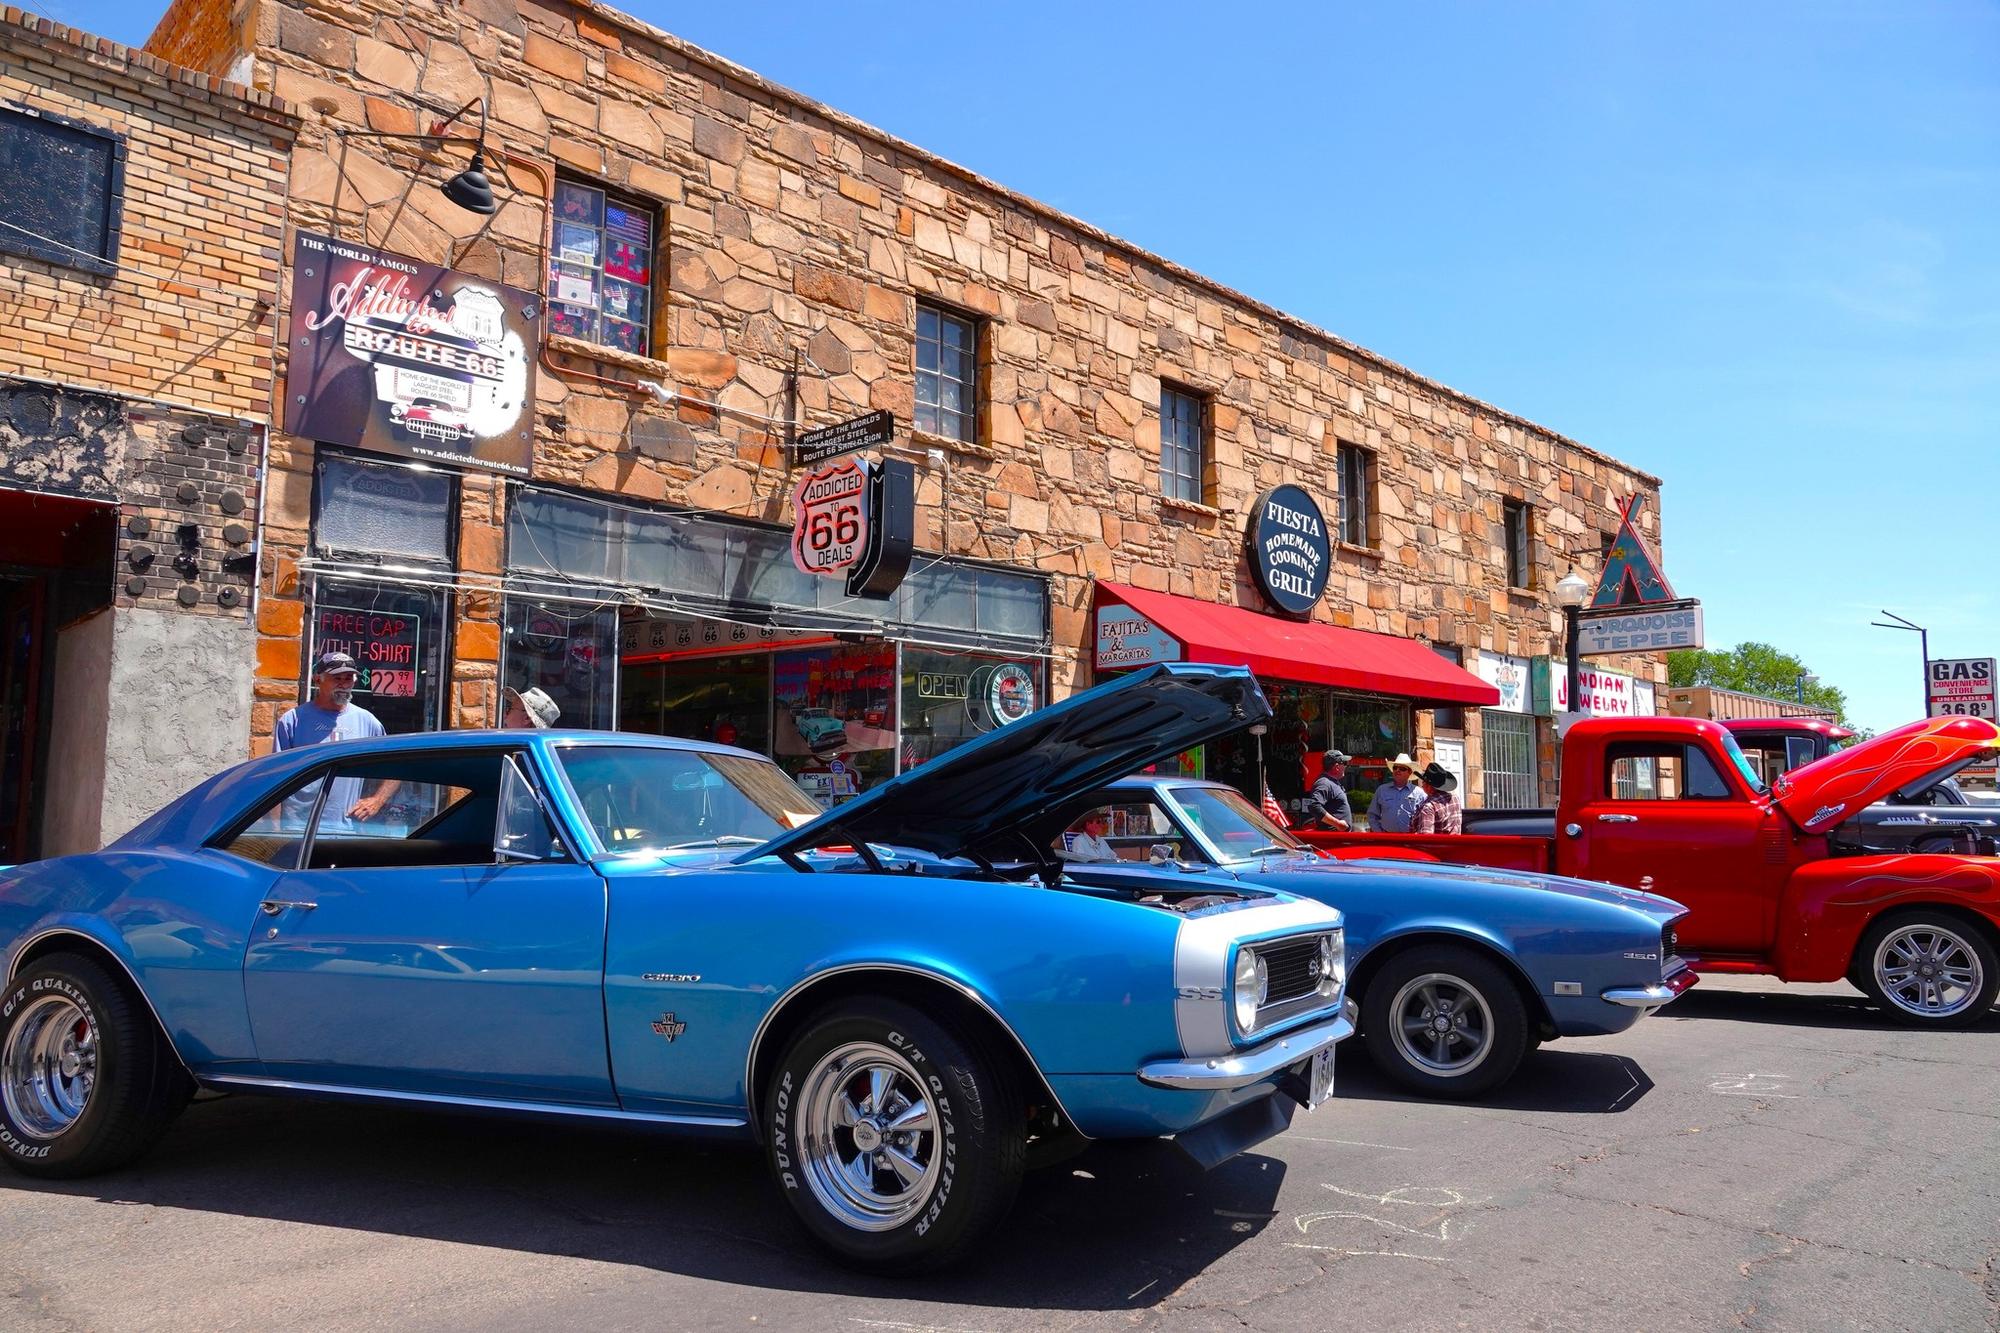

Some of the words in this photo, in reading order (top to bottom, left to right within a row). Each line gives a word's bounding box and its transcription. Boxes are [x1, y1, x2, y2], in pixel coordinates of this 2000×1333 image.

[301, 238, 325, 252] THE
[327, 244, 370, 263] WORLD
[372, 255, 418, 275] FAMOUS
[305, 267, 456, 331] Addicted
[406, 317, 437, 335] to
[354, 327, 456, 370] ROUTE
[466, 353, 498, 378] 66
[400, 372, 419, 381] HOME
[803, 431, 824, 444] HOME
[825, 429, 835, 437] OF
[836, 424, 849, 434] THE
[815, 434, 845, 449] LARGEST
[847, 427, 868, 440] STEEL
[803, 449, 825, 463] ROUTE
[826, 445, 836, 455] 66
[837, 439, 864, 452] SHIELD
[864, 432, 882, 444] SIGN
[412, 446, 529, 475] www.addictedtoroute66.com
[809, 473, 863, 501] ADDICTED
[830, 501, 840, 514] TO
[810, 505, 860, 551] 66
[1267, 501, 1321, 537] FIESTA
[817, 545, 853, 566] DEALS
[1265, 532, 1321, 567] HOMEMADE
[1269, 550, 1316, 579] COOKING
[1269, 568, 1316, 599] GRILL
[321, 612, 365, 635] FREE
[370, 617, 406, 638] CAP
[1102, 620, 1149, 637] FAJITAS
[1582, 611, 1695, 634] TURQUOISE
[625, 638, 638, 648] 66
[652, 636, 664, 646] 66
[678, 633, 691, 643] 66
[704, 631, 717, 641] 66
[732, 629, 745, 639] 66
[1111, 637, 1123, 652] &
[1592, 631, 1689, 649] TEPEE
[354, 640, 413, 664] T-SHIRT
[1099, 649, 1150, 664] MARGARITAS
[1933, 661, 1989, 680] GAS
[921, 674, 967, 697] OPEN
[1579, 672, 1624, 693] NDIAN
[1933, 679, 1988, 689] CONVENIENCE
[1948, 687, 1975, 695] STORE
[1557, 675, 1628, 713] JWELRY
[1178, 986, 1225, 1000] SS
[3, 986, 26, 1017] G/T
[32, 977, 100, 1041] QUALIFIER
[775, 1071, 799, 1190] DUNLOP
[887, 1031, 926, 1064] G/T
[914, 1075, 957, 1237] QUALIFIER
